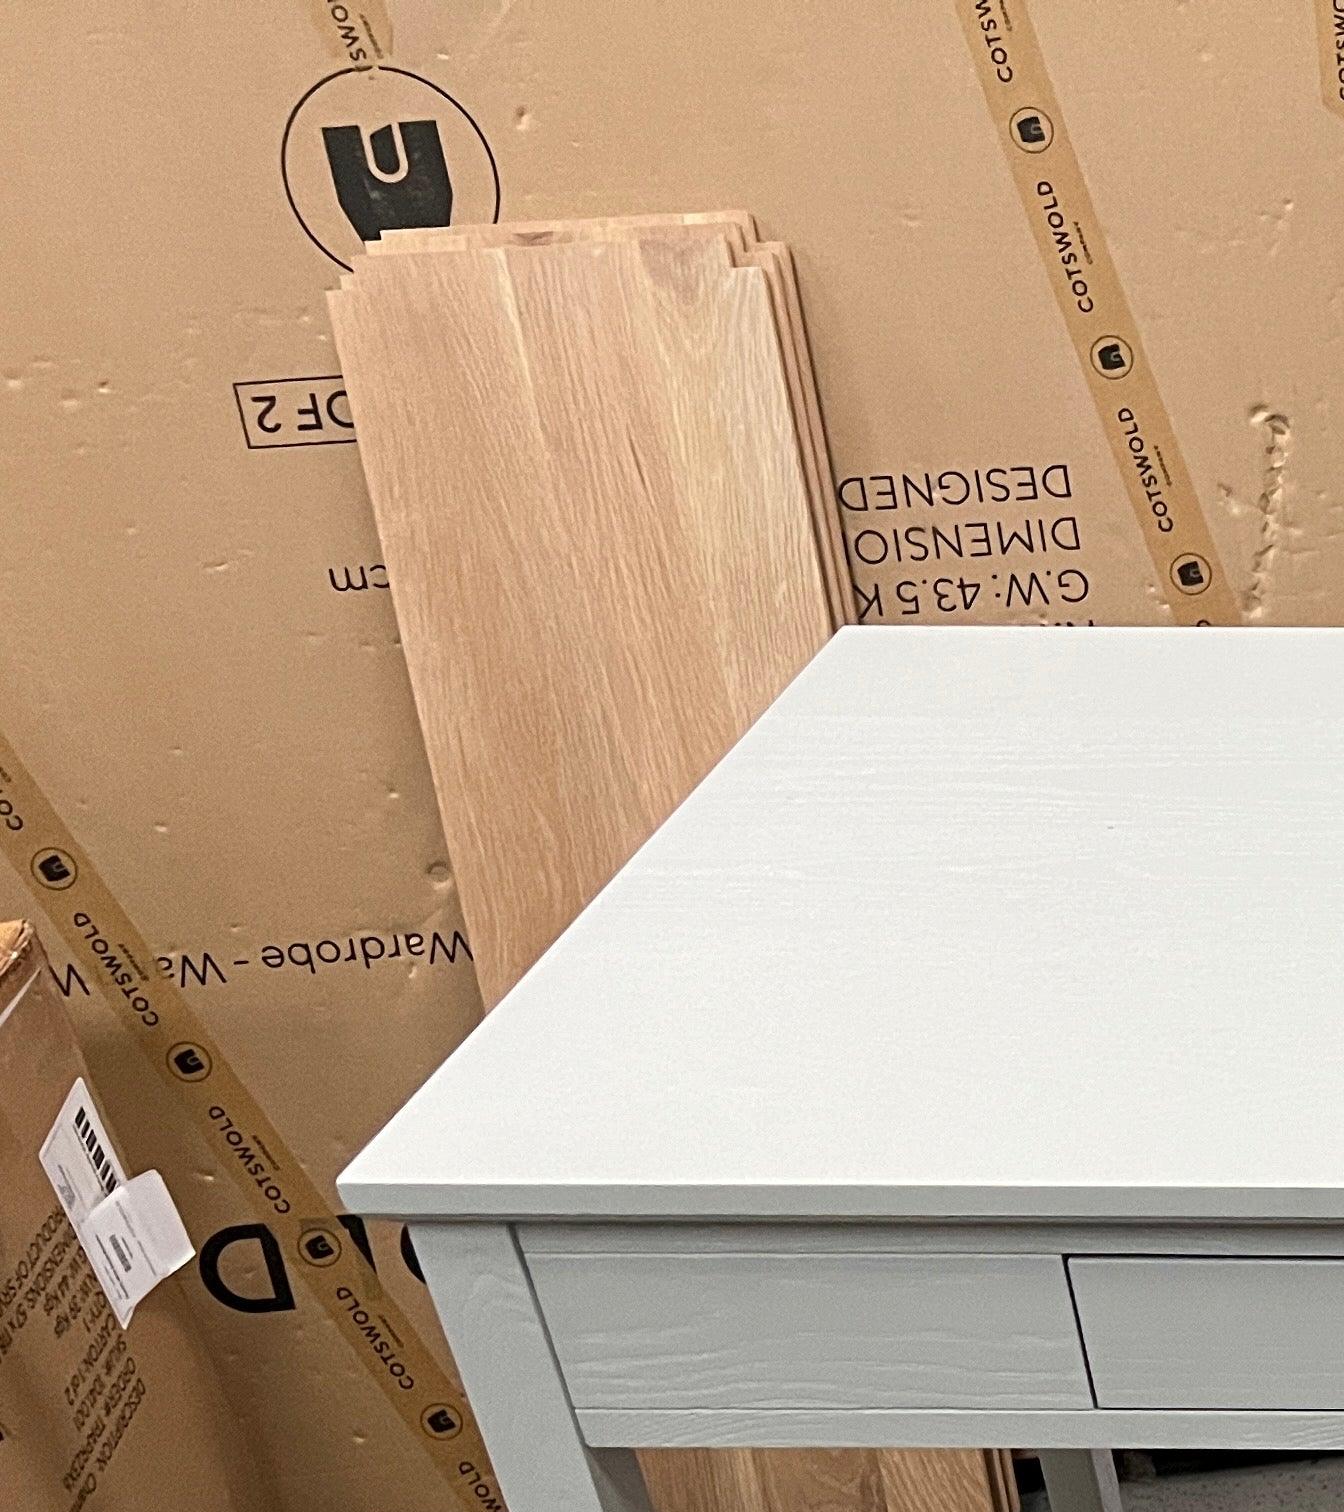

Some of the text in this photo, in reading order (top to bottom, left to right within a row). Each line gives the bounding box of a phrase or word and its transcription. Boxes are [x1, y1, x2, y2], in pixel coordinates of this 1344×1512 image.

[1036, 181, 1094, 313] COTSWOLD
[251, 395, 282, 433] 2
[839, 465, 1072, 511] DESIGNED
[1117, 407, 1173, 532] COTSWOLD
[896, 577, 981, 616] 43.5
[73, 912, 159, 1027] COTSWOLD
[262, 930, 474, 974] Wardrobe
[208, 1105, 291, 1214] COTSWOLD
[336, 1286, 414, 1391] COTSWOLD
